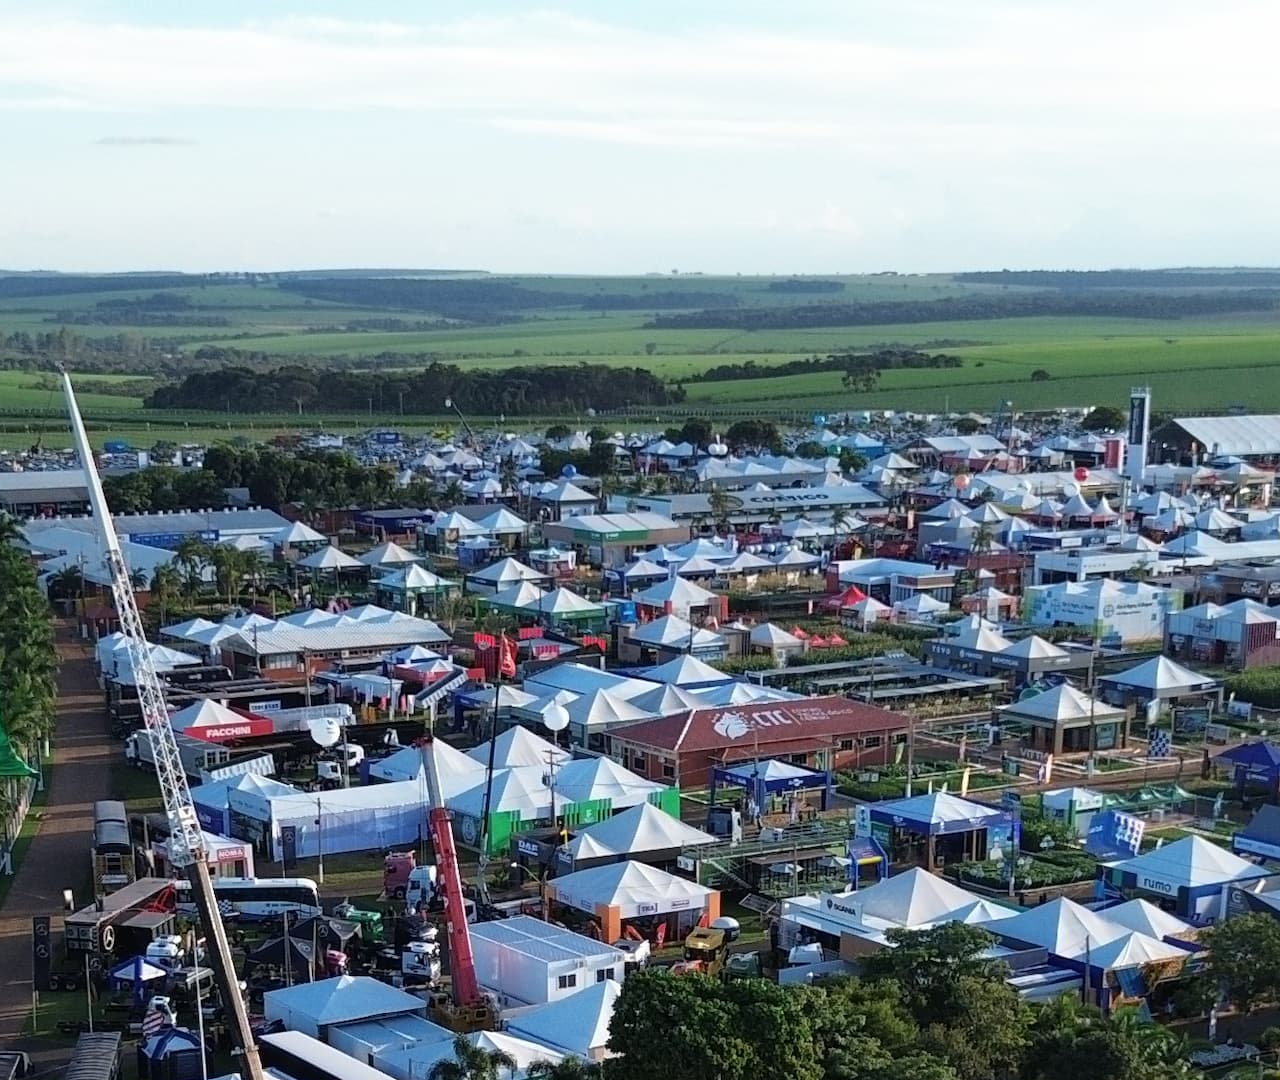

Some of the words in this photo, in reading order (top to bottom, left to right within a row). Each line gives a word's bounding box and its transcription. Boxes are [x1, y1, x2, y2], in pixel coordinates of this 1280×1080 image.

[752, 709, 792, 727] CTC
[206, 726, 251, 738] FACCHINI
[219, 849, 243, 859] NOMA
[1143, 877, 1172, 893] rumo
[833, 903, 856, 916] SCANIA
